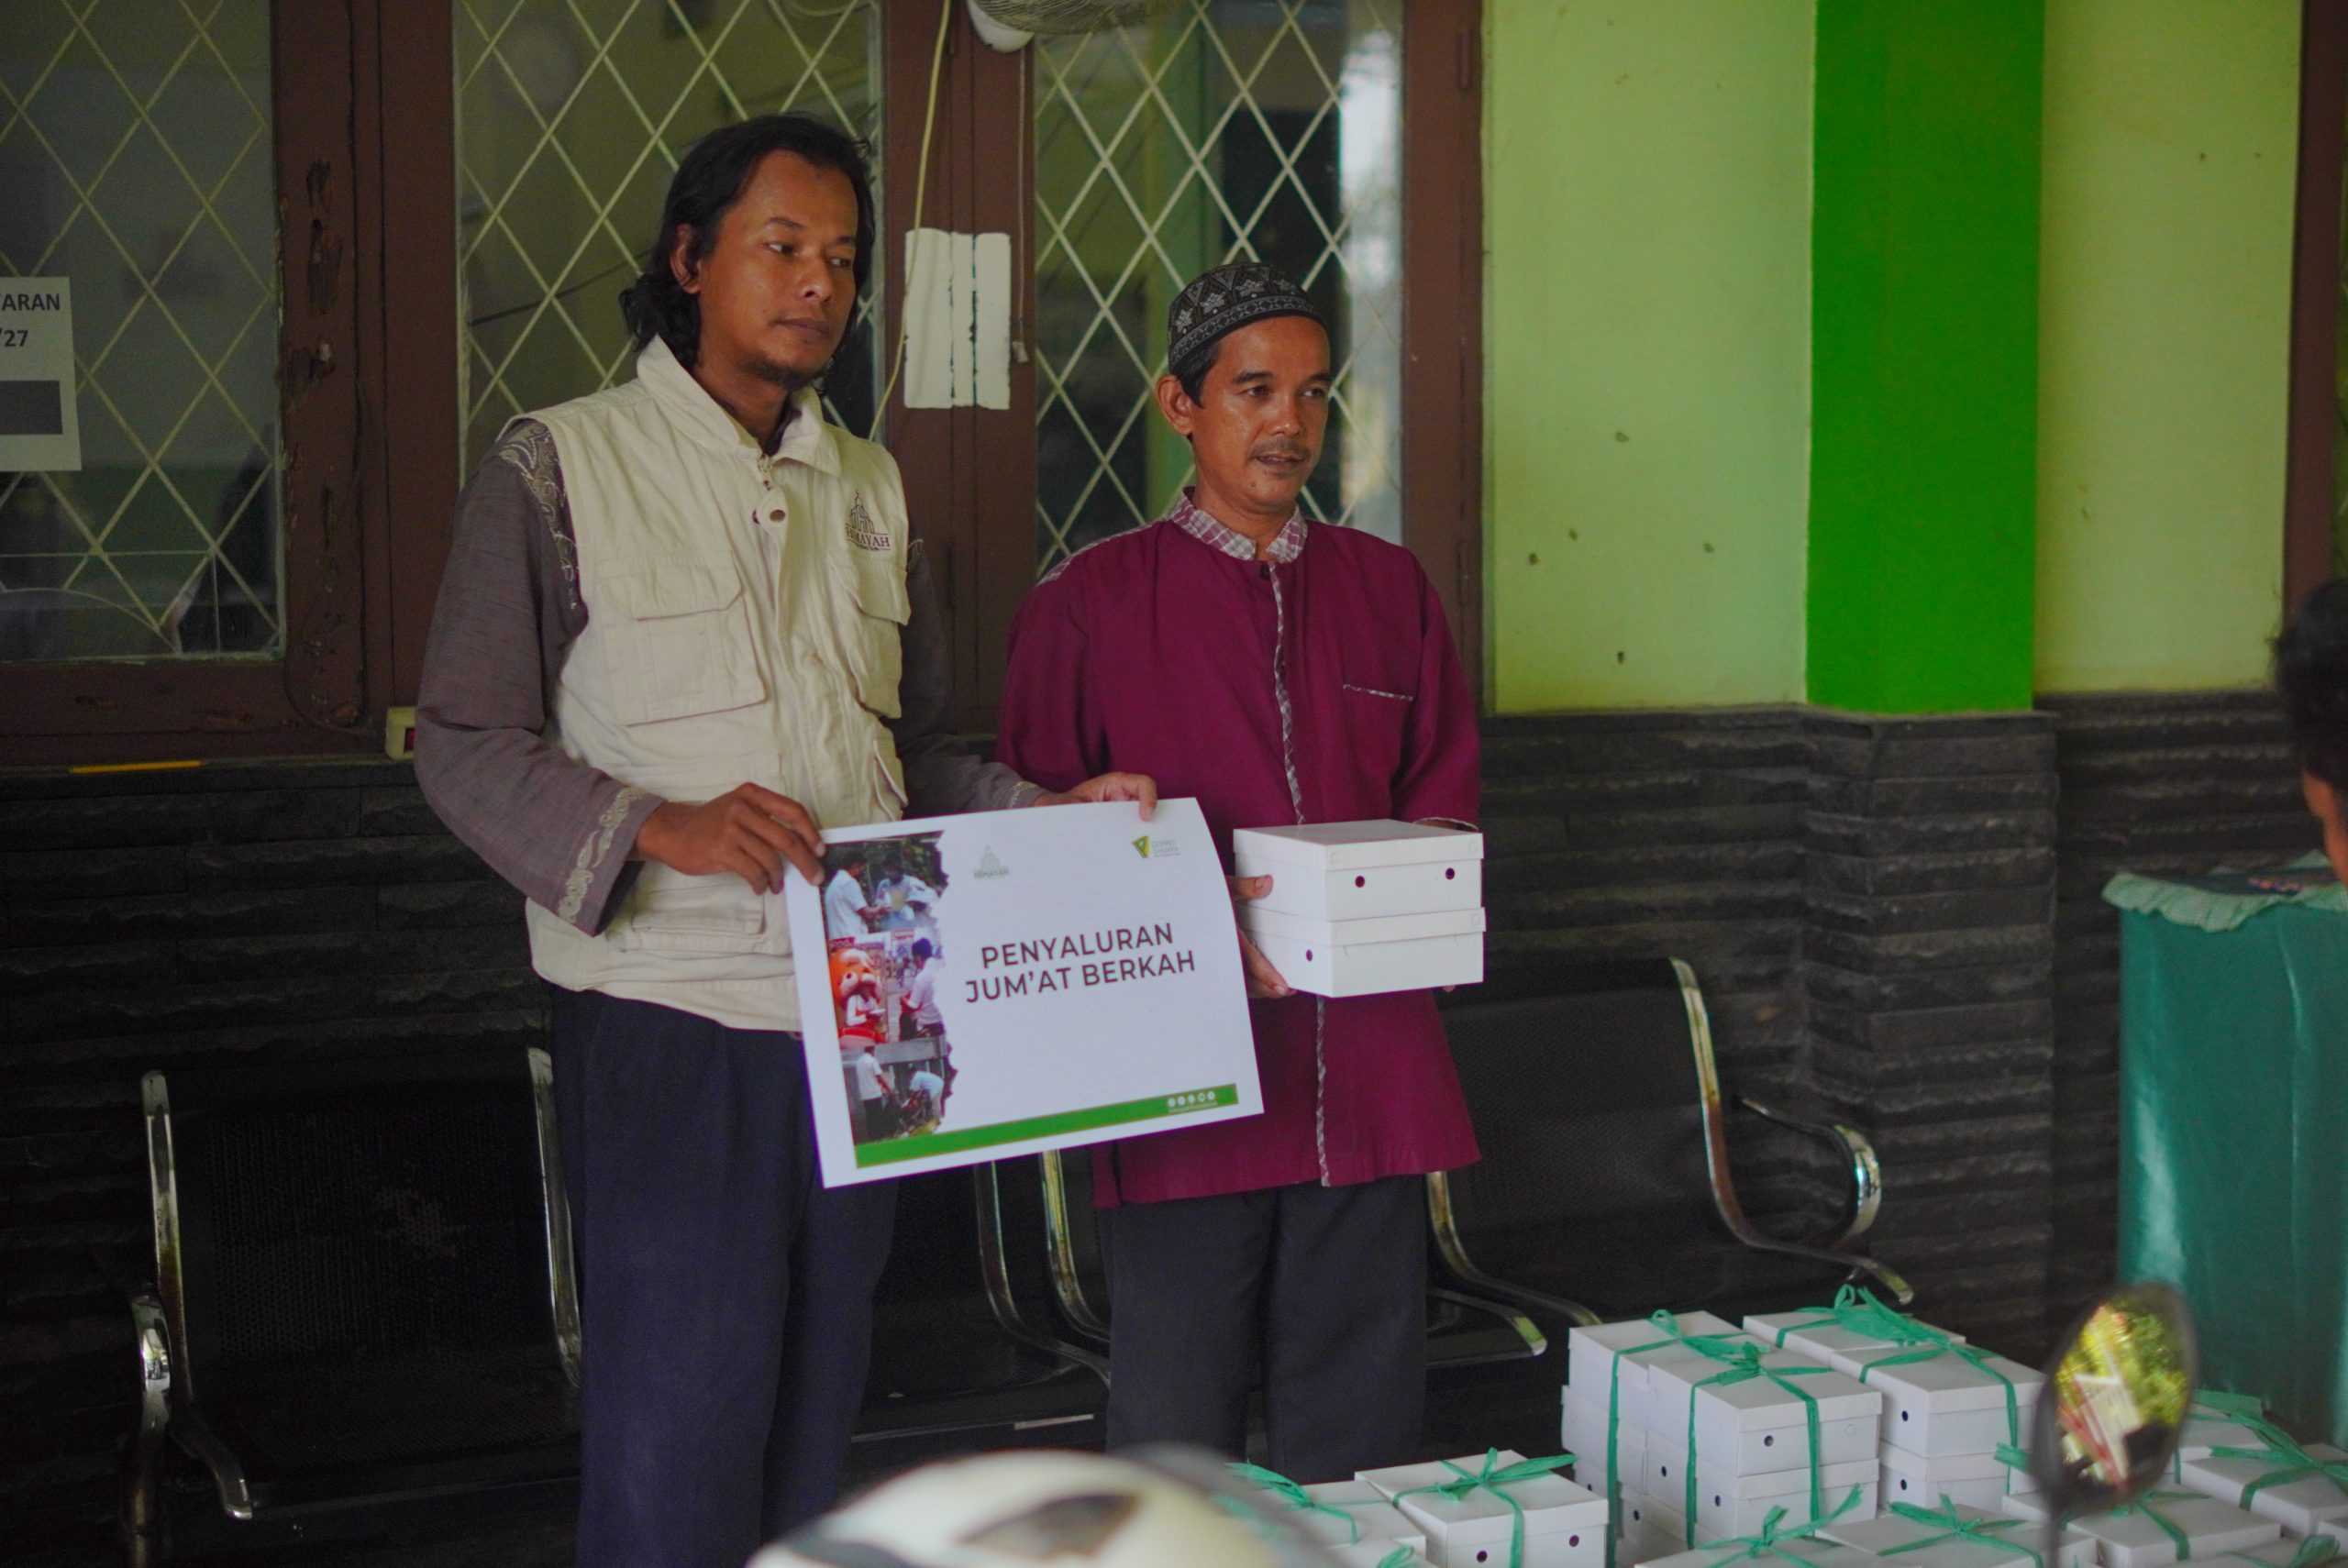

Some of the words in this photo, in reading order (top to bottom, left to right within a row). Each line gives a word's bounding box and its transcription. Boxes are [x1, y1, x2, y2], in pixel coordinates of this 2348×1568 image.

[0, 293, 61, 311] ARAN
[981, 922, 1173, 968] PENYALURAN
[1081, 950, 1196, 987] BERKAH
